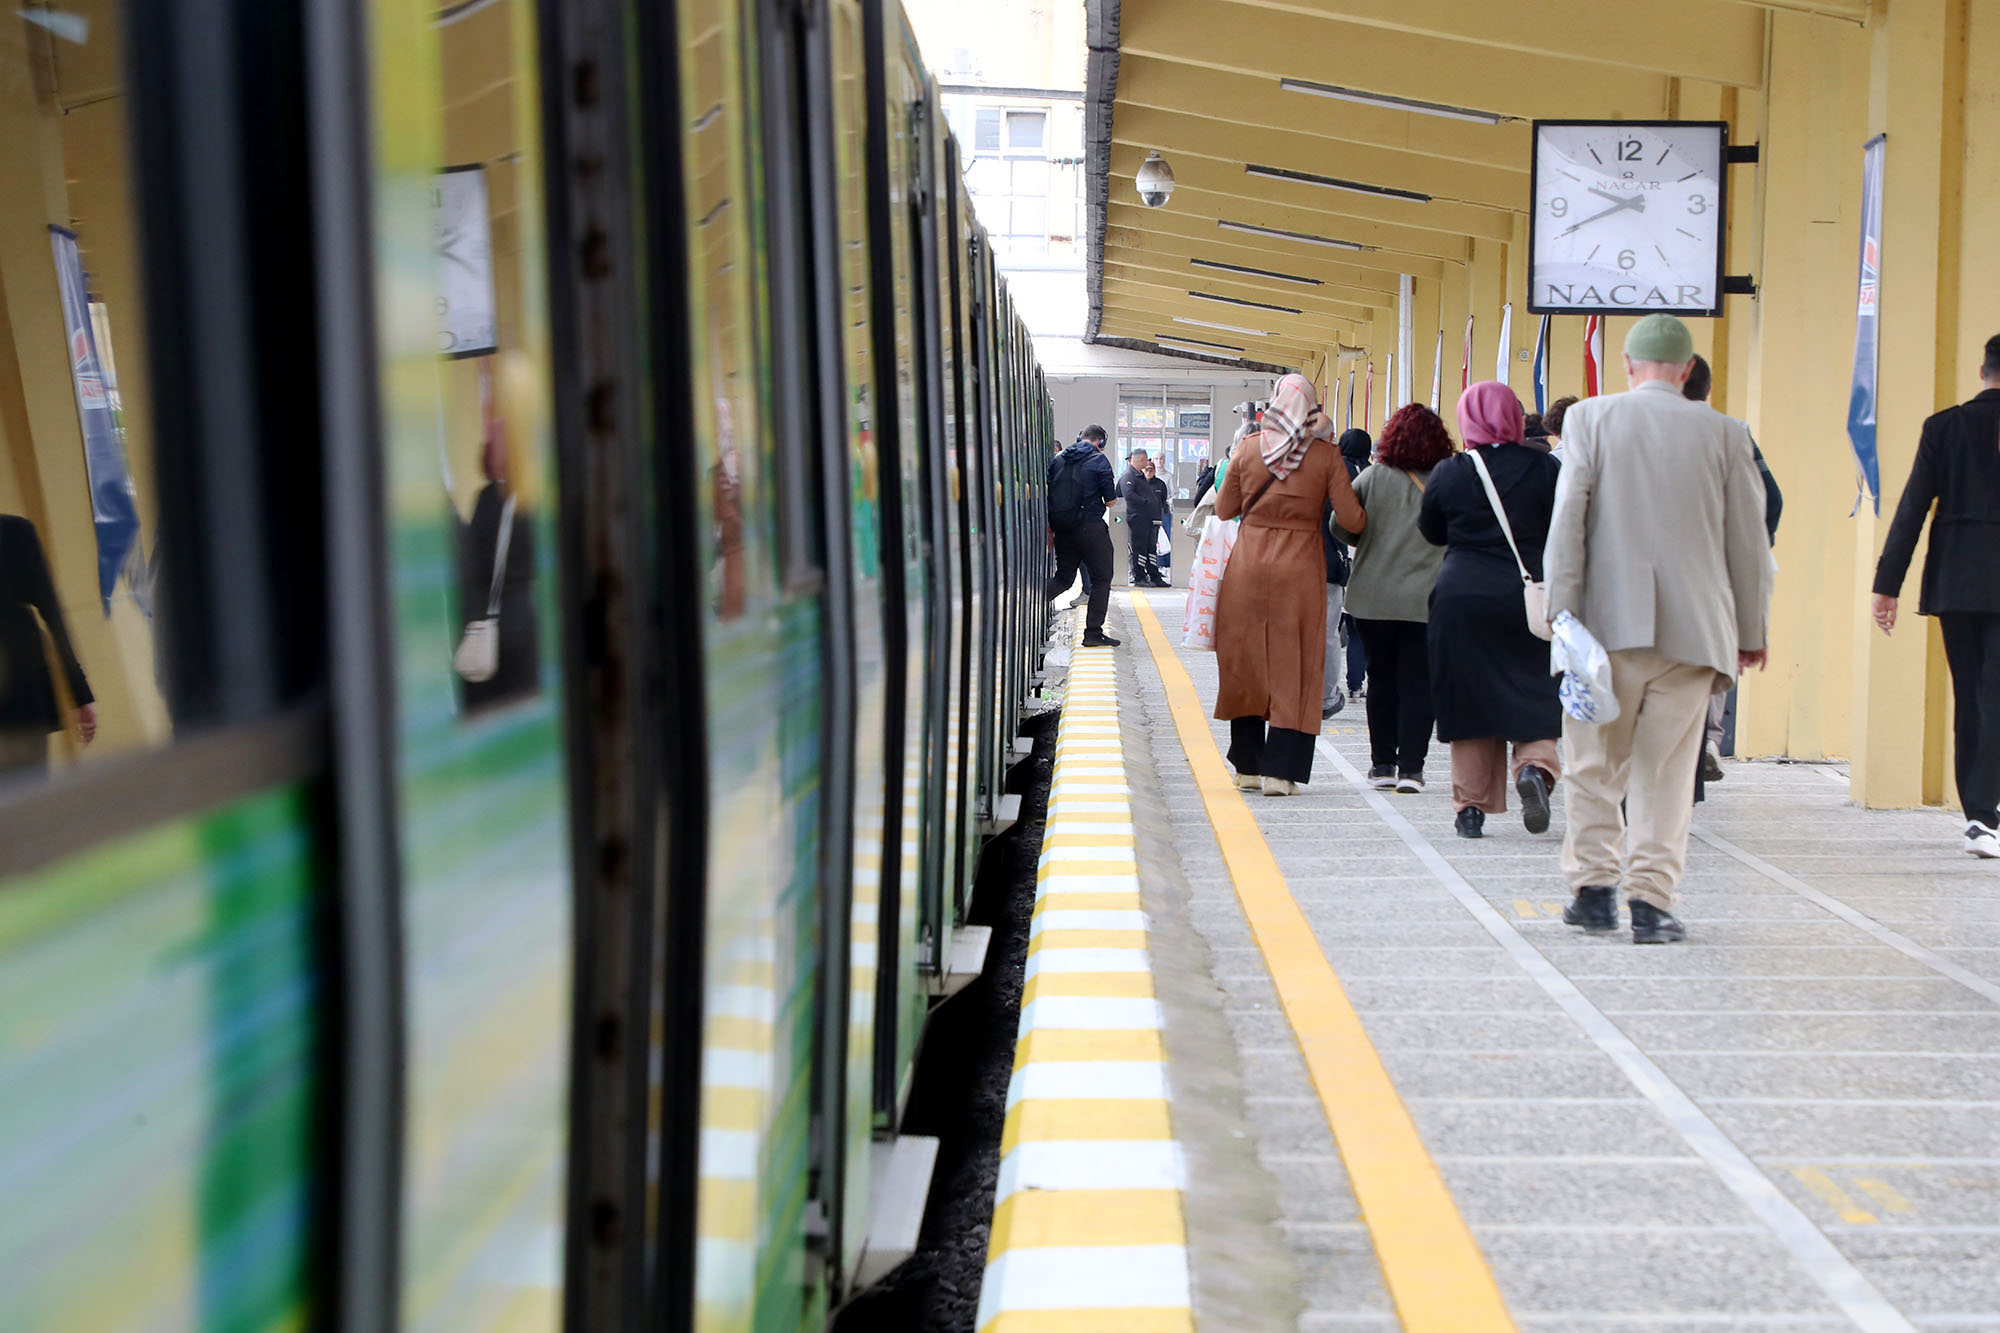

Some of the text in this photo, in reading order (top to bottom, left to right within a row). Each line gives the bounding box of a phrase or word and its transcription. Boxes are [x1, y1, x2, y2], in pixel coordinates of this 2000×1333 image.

[1617, 140, 1643, 161] 12
[1595, 181, 1662, 191] NACAR
[1550, 196, 1569, 218] 9
[1686, 194, 1707, 215] 3
[1617, 248, 1636, 270] 6
[1546, 284, 1707, 306] NACAR
